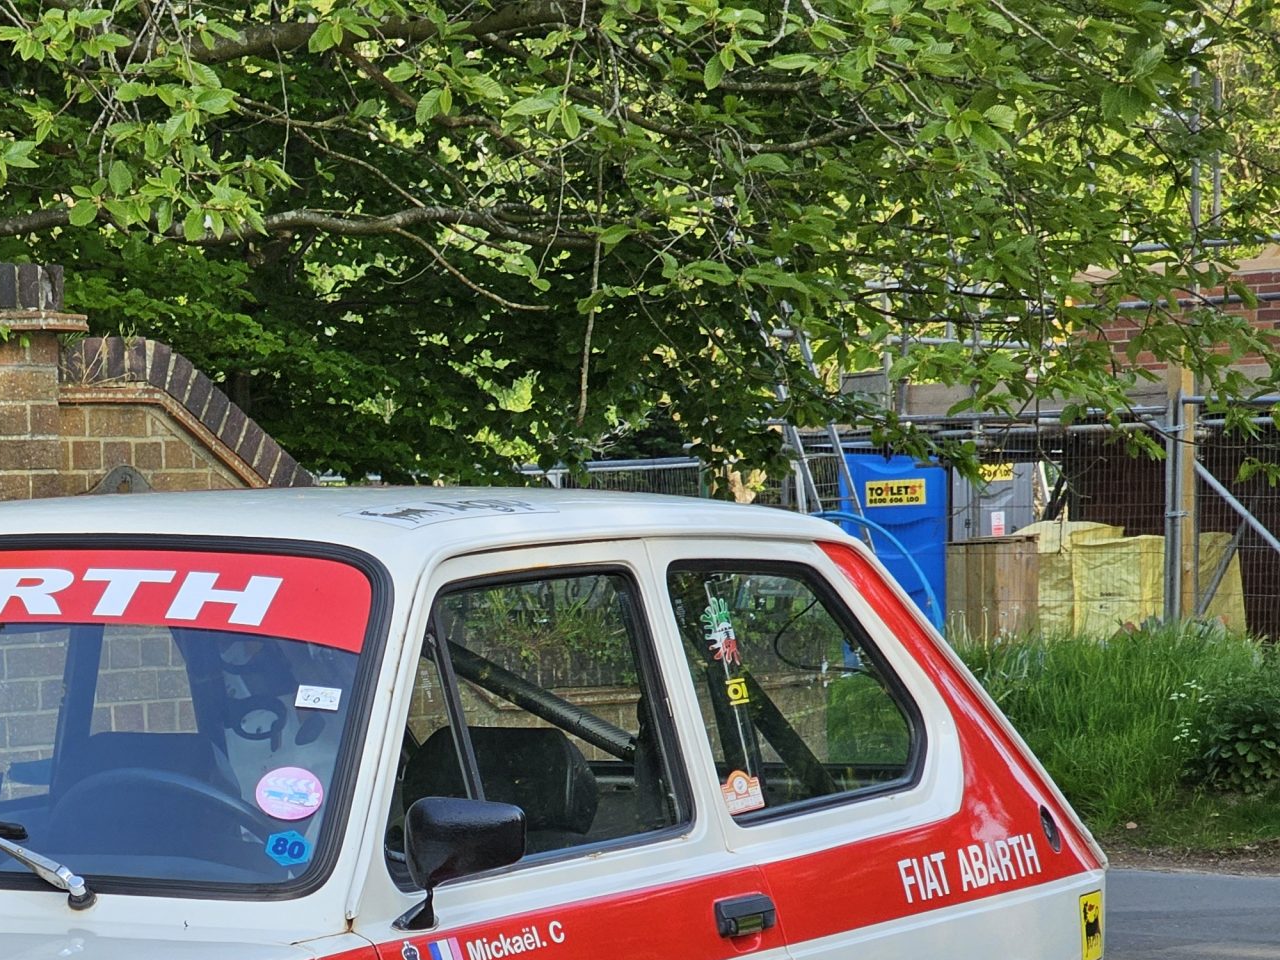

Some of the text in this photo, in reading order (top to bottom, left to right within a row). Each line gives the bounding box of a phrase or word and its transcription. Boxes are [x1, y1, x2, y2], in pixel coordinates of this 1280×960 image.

[272, 837, 306, 860] 80
[898, 833, 1042, 904] FIAT ABARTH
[549, 920, 565, 944] C
